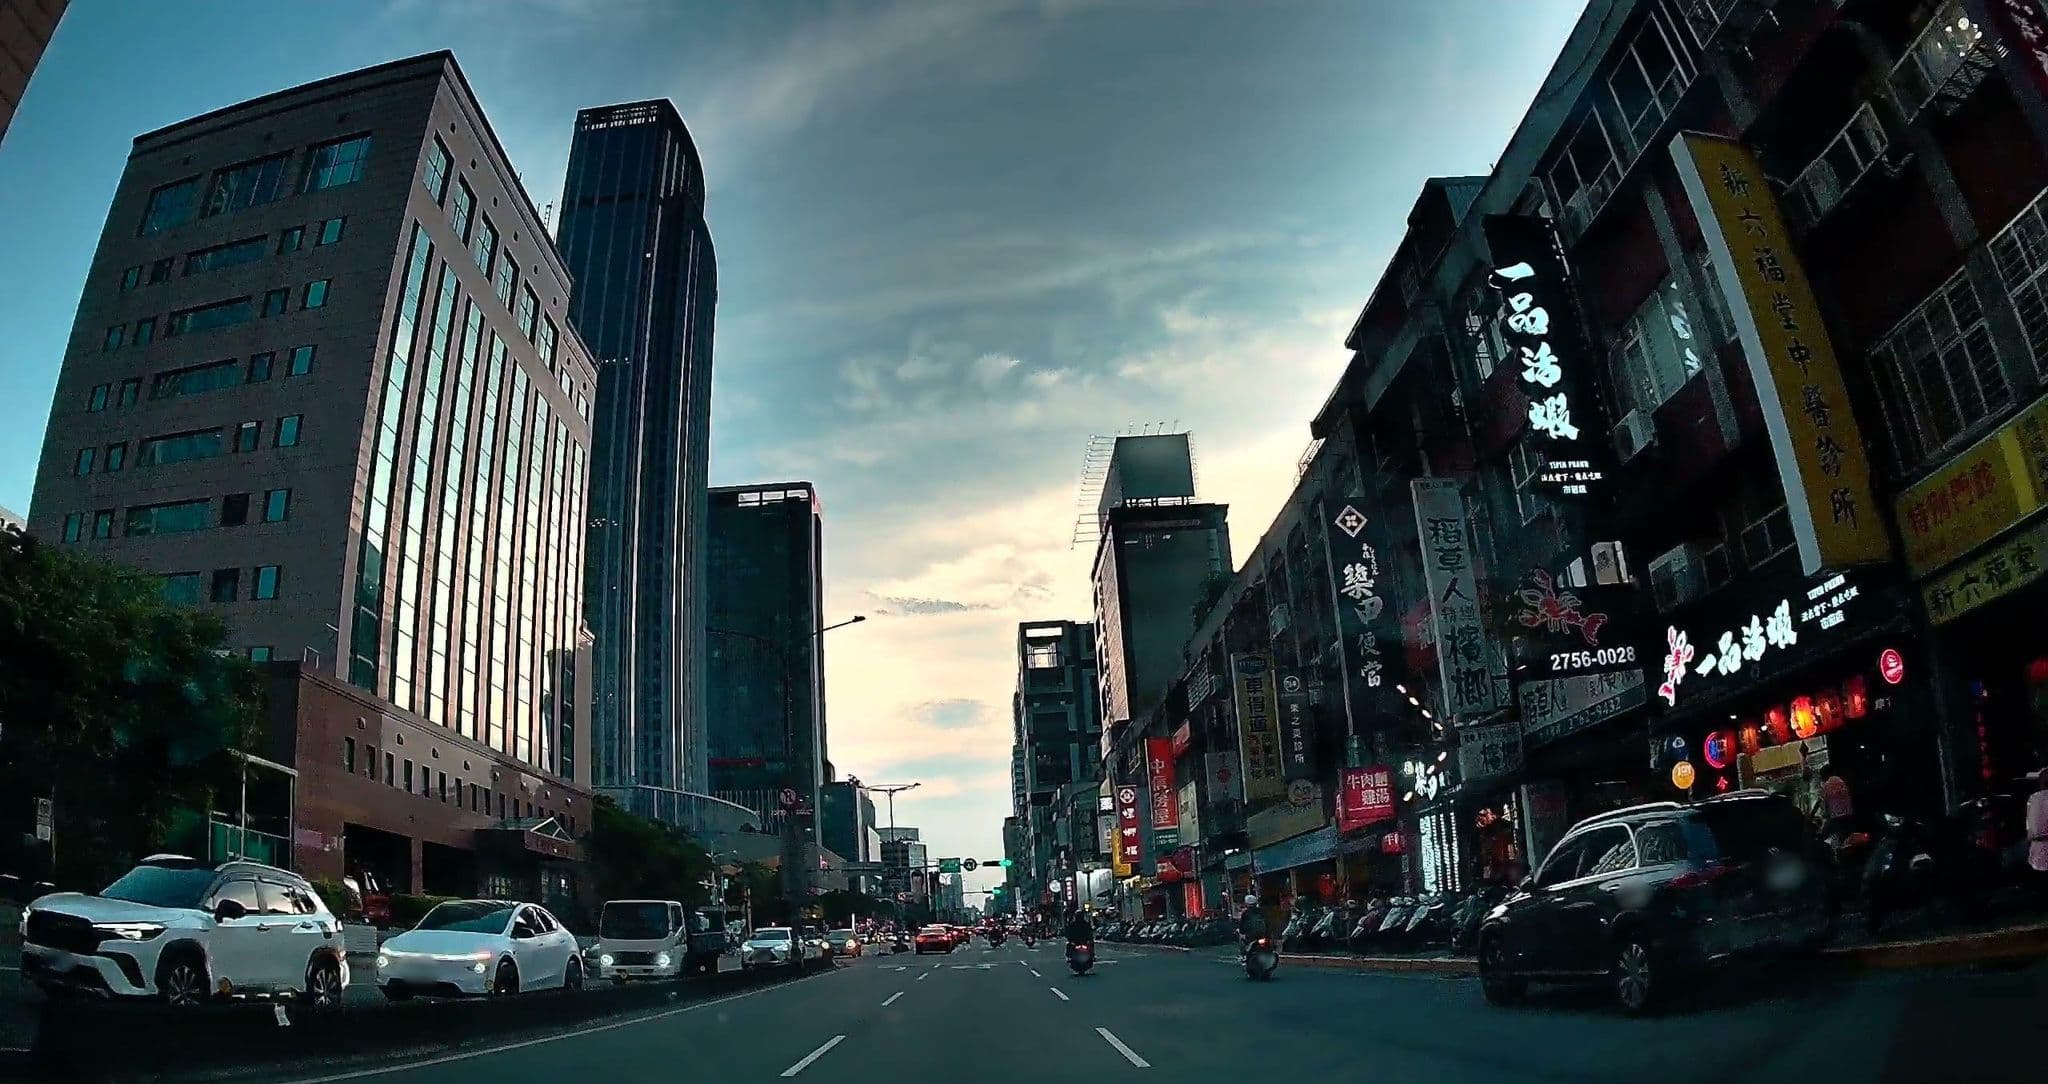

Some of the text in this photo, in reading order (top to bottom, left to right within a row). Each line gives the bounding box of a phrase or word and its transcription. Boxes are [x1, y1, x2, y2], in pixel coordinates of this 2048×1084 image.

[1494, 261, 1580, 440] 一品活蝦
[1718, 159, 1860, 532] 新六福堂中醫診所
[1551, 645, 1637, 672] 2756-0028
[1694, 598, 1798, 677] 一品活蝦
[1151, 757, 1172, 826] 中信房屋
[1346, 771, 1390, 790] 牛肉麵
[1361, 788, 1390, 807] 雞湯
